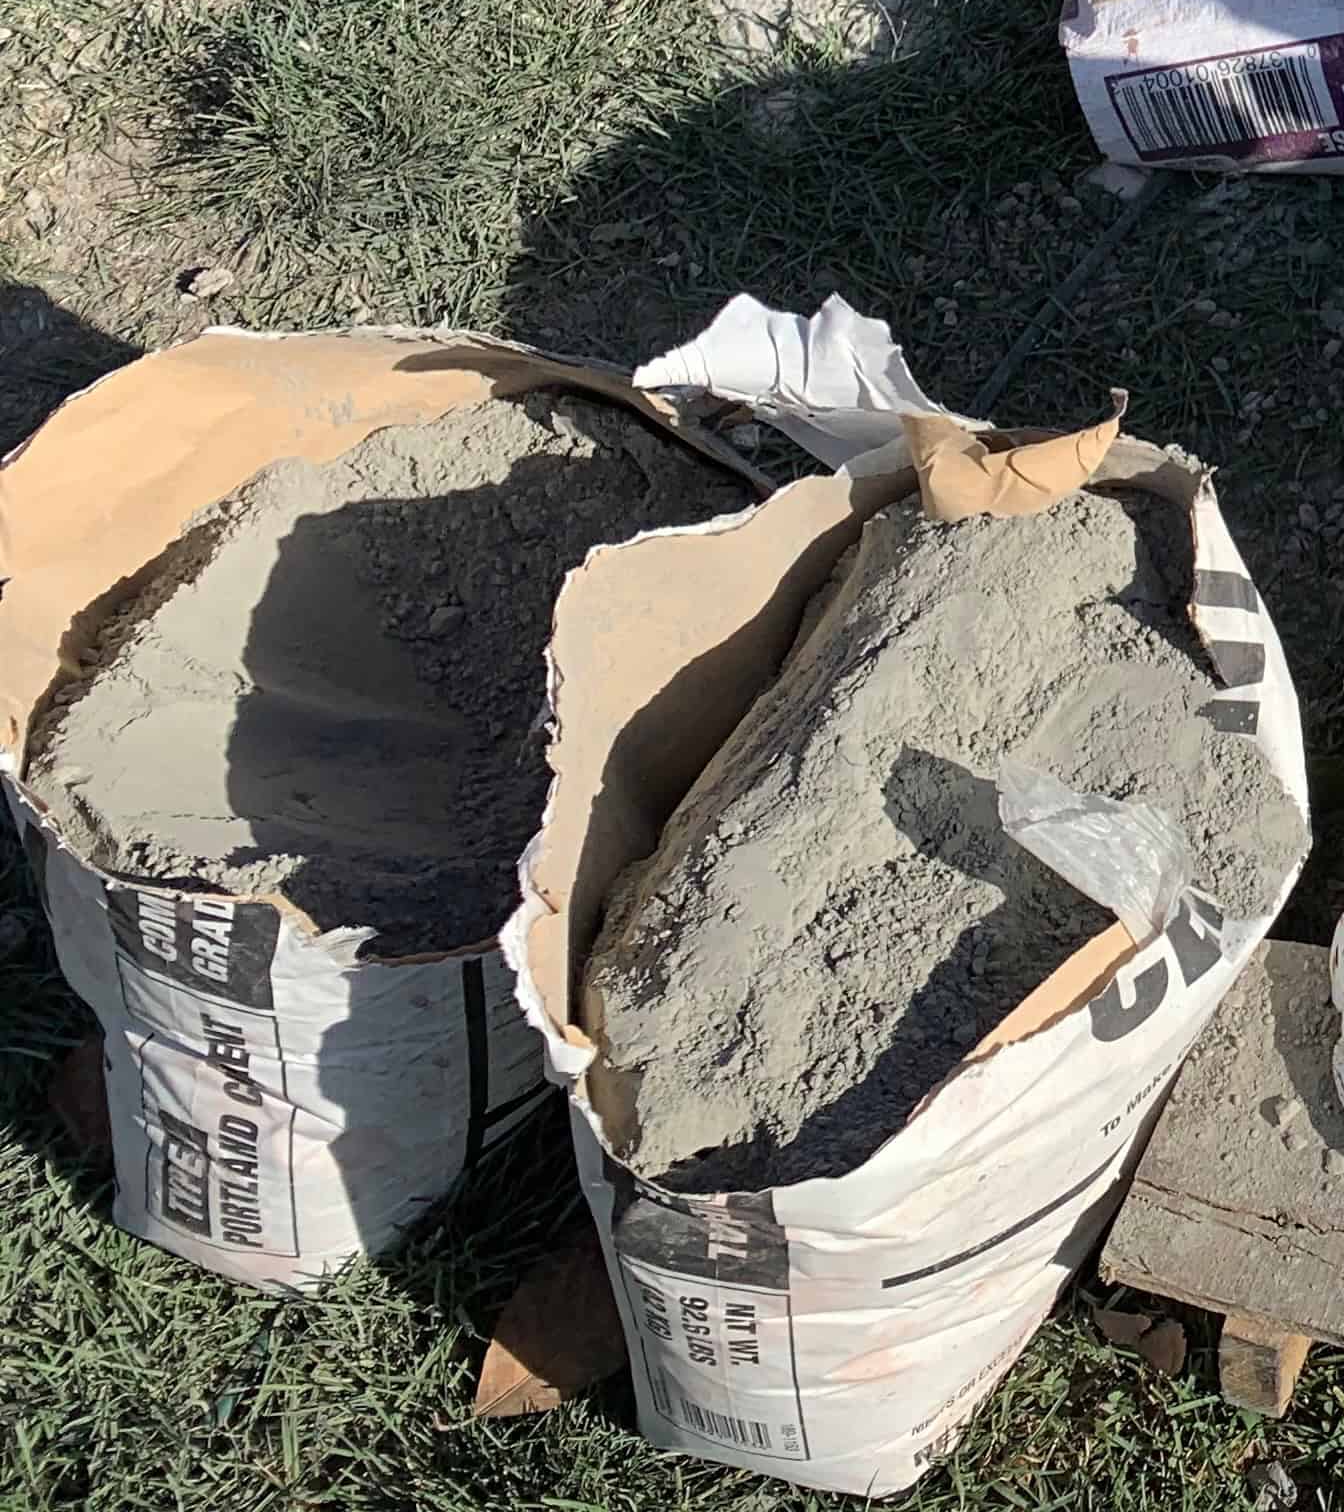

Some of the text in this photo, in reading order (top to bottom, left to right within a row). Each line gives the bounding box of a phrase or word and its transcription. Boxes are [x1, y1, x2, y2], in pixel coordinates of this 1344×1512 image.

[1143, 62, 1210, 94] 01004
[1217, 50, 1283, 76] 37826
[191, 897, 235, 983] GRAD
[1099, 1063, 1173, 1139] To Make
[166, 1143, 206, 1222] TYPE
[217, 1114, 263, 1249] PORTLAND
[679, 1295, 718, 1367] 92.6 LBS
[728, 1339, 761, 1366] WT.
